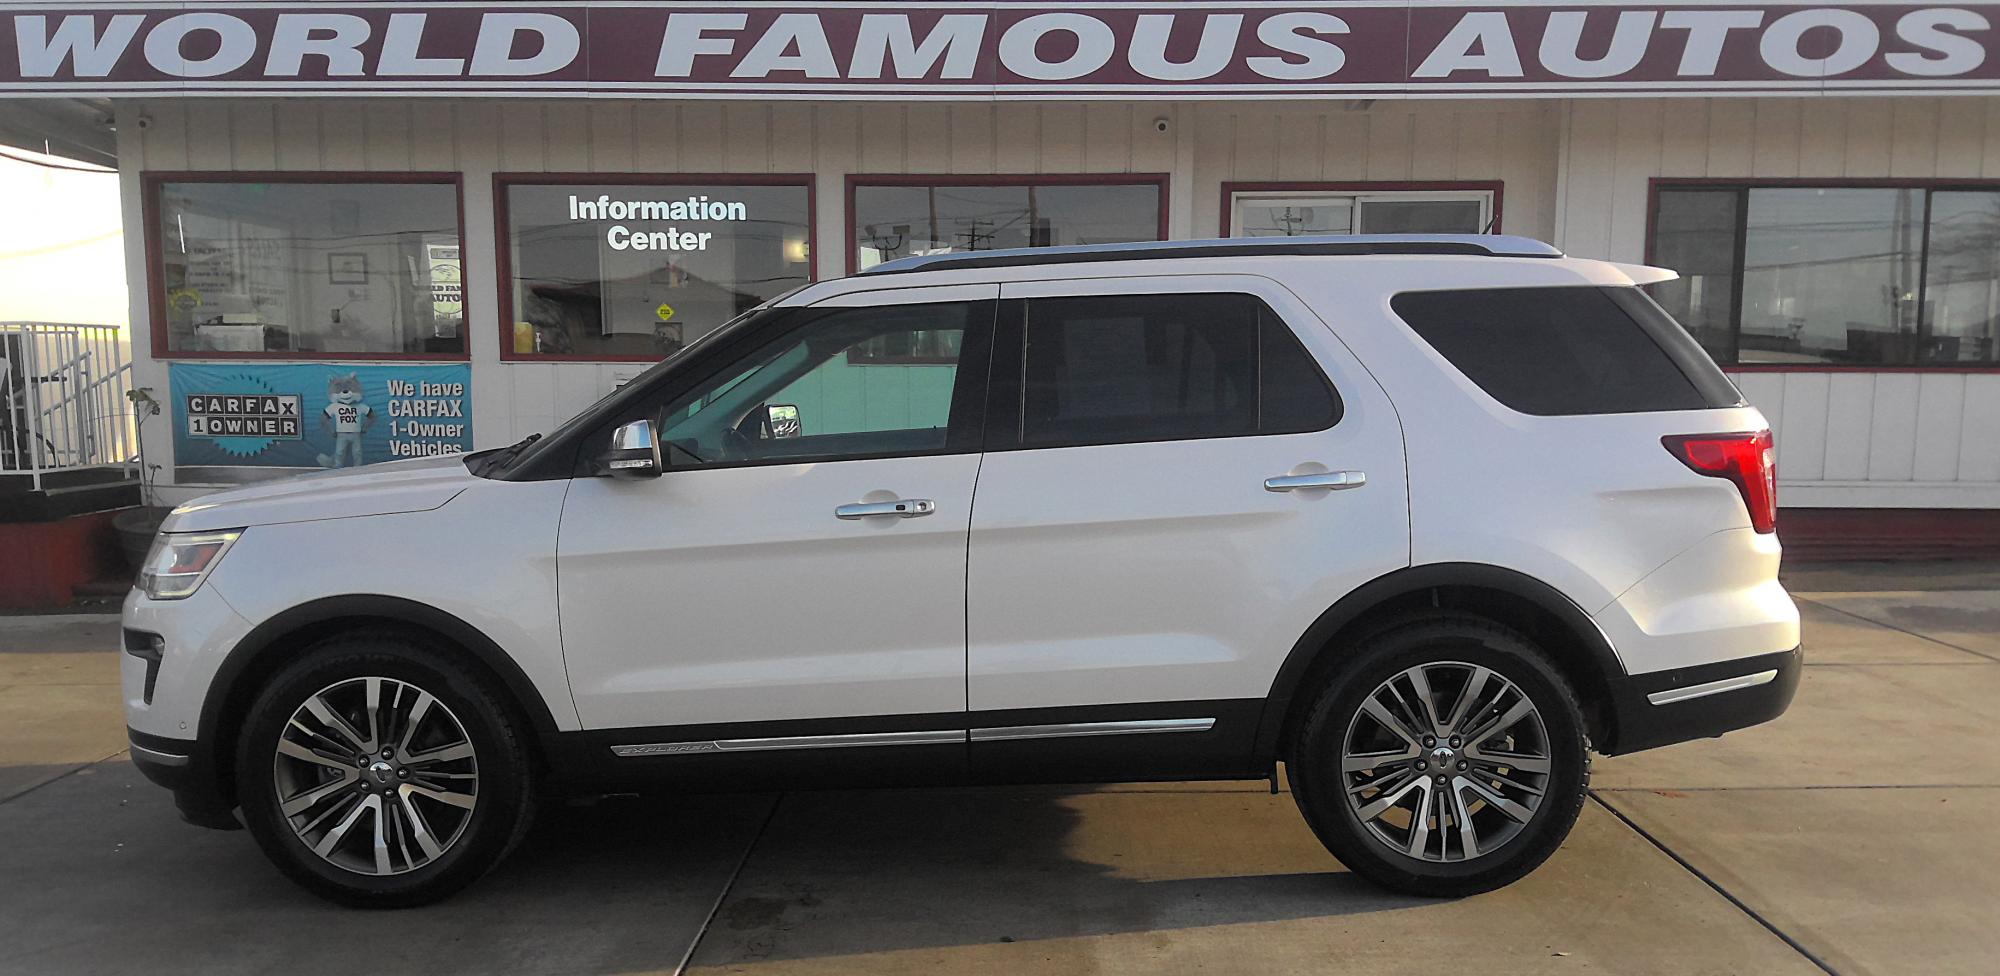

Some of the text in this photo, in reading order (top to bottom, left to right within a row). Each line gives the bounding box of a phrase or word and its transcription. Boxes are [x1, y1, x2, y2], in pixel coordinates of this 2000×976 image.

[14, 7, 1987, 80] WORLD FAMOUS AUTOS
[569, 194, 746, 221] Information
[607, 226, 712, 251] Center
[387, 380, 463, 397] We have
[189, 397, 297, 416] CARFAX
[338, 406, 358, 416] CAR
[388, 399, 463, 417] CARFAX
[339, 415, 358, 425] FOX
[389, 420, 464, 437] 1-Owner
[389, 439, 462, 456] Vehicles
